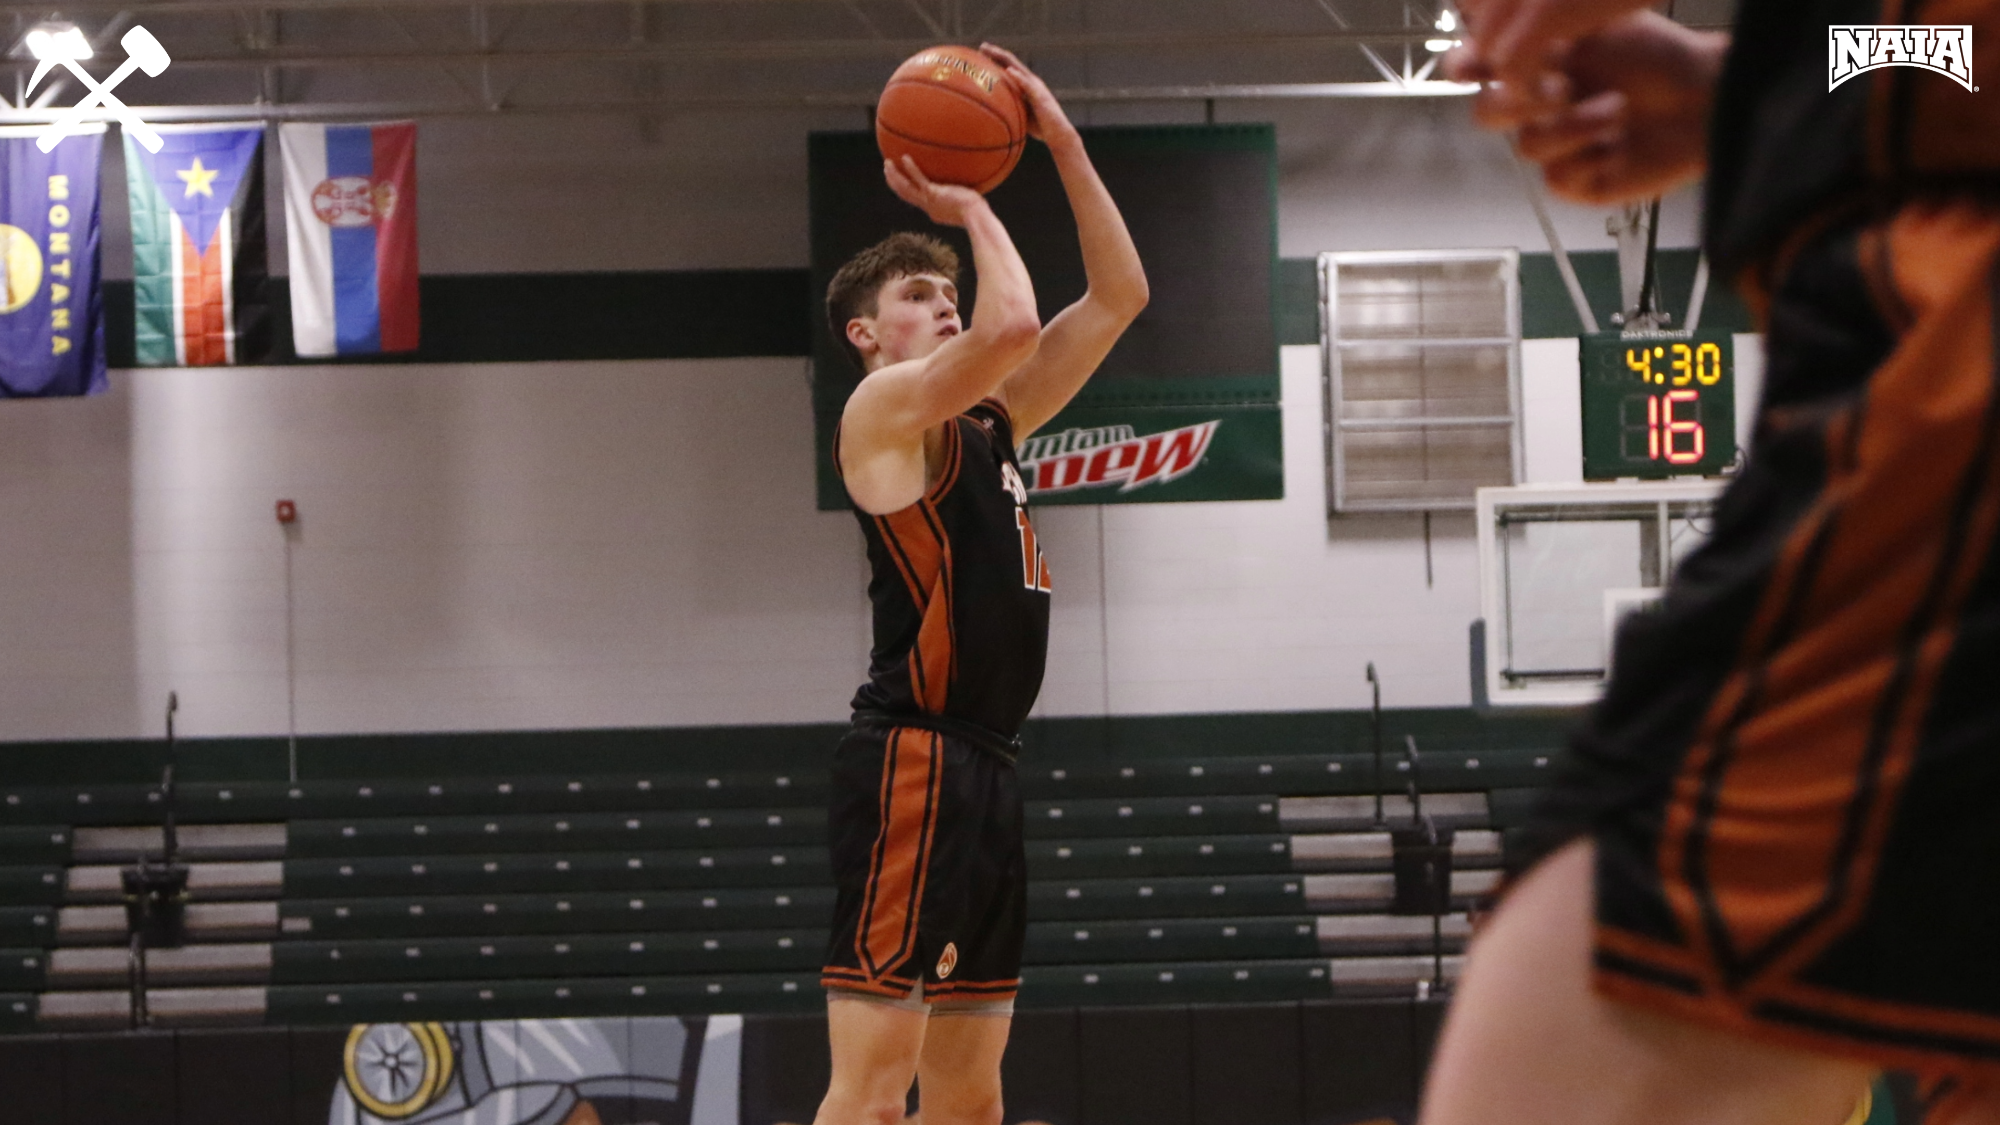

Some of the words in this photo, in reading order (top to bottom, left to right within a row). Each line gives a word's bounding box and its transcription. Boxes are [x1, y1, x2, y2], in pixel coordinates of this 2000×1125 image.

[48, 174, 72, 355] MONTANA
[1621, 330, 1694, 340] DAKTRONICS
[1626, 343, 1721, 386] 4:30
[1017, 424, 1135, 465] ntain
[1648, 389, 1705, 464] 16
